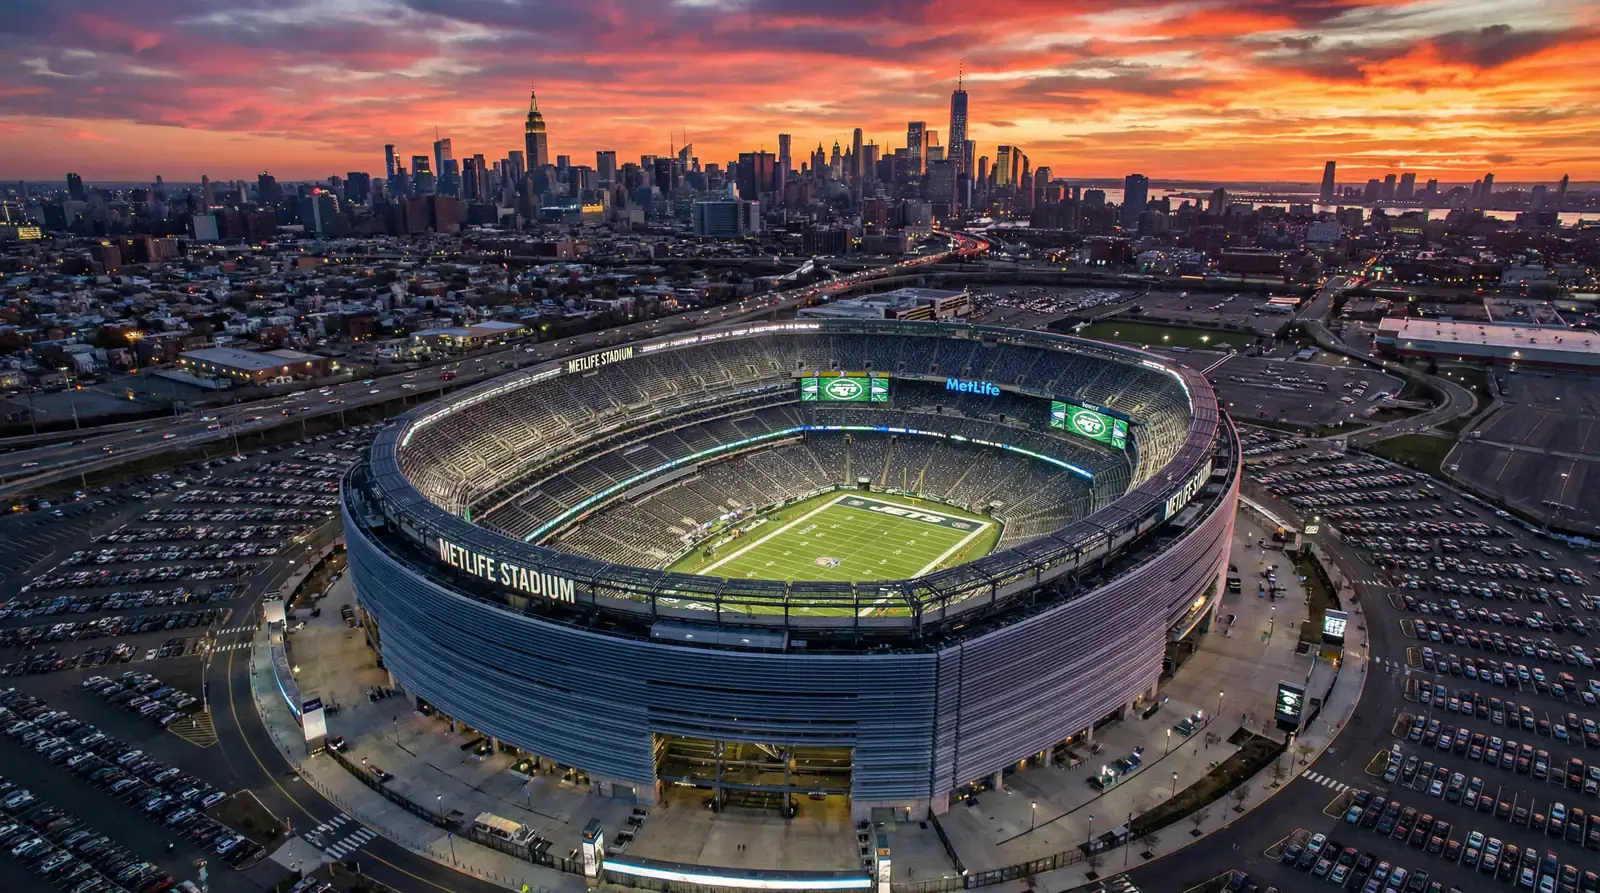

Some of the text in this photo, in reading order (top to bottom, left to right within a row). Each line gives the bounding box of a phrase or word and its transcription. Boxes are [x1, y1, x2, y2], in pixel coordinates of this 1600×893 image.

[568, 346, 633, 374] METLIFE STADIUM
[946, 378, 1000, 396] MetLife
[869, 505, 946, 523] JETS
[439, 537, 575, 604] METLIFE STADIUM
